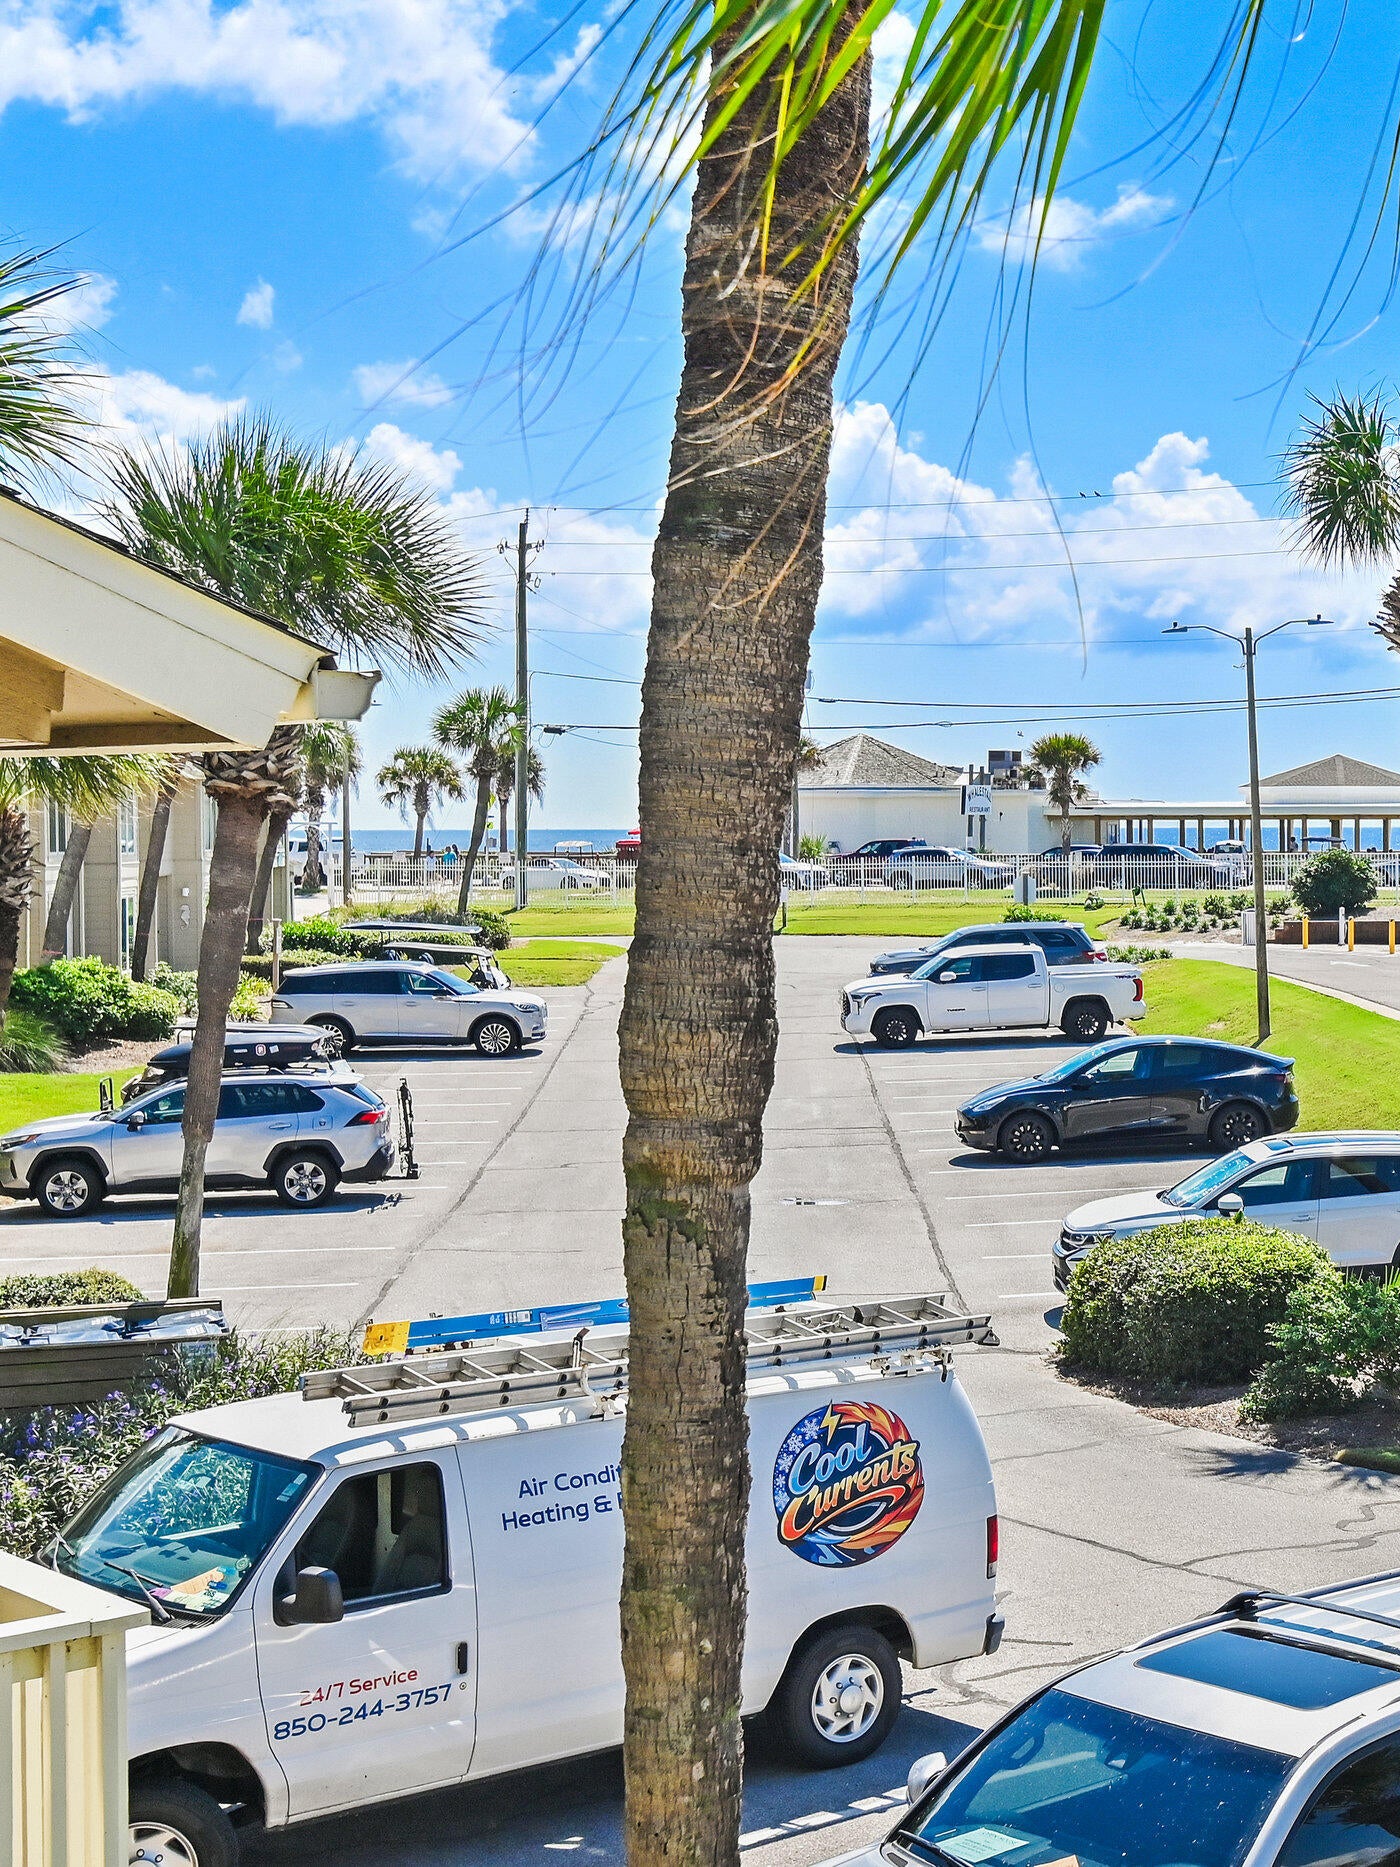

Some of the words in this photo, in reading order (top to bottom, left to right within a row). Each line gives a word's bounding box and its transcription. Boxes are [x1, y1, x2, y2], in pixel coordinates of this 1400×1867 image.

[518, 1477, 548, 1498] Air
[554, 1464, 621, 1491] Condit
[788, 1422, 872, 1495] Cool
[502, 1502, 590, 1531] Heating
[594, 1495, 613, 1513] &
[780, 1440, 918, 1541] Currents
[300, 1681, 345, 1706] 24/7
[349, 1669, 418, 1695] Service
[273, 1683, 452, 1740] 850-244-3757
